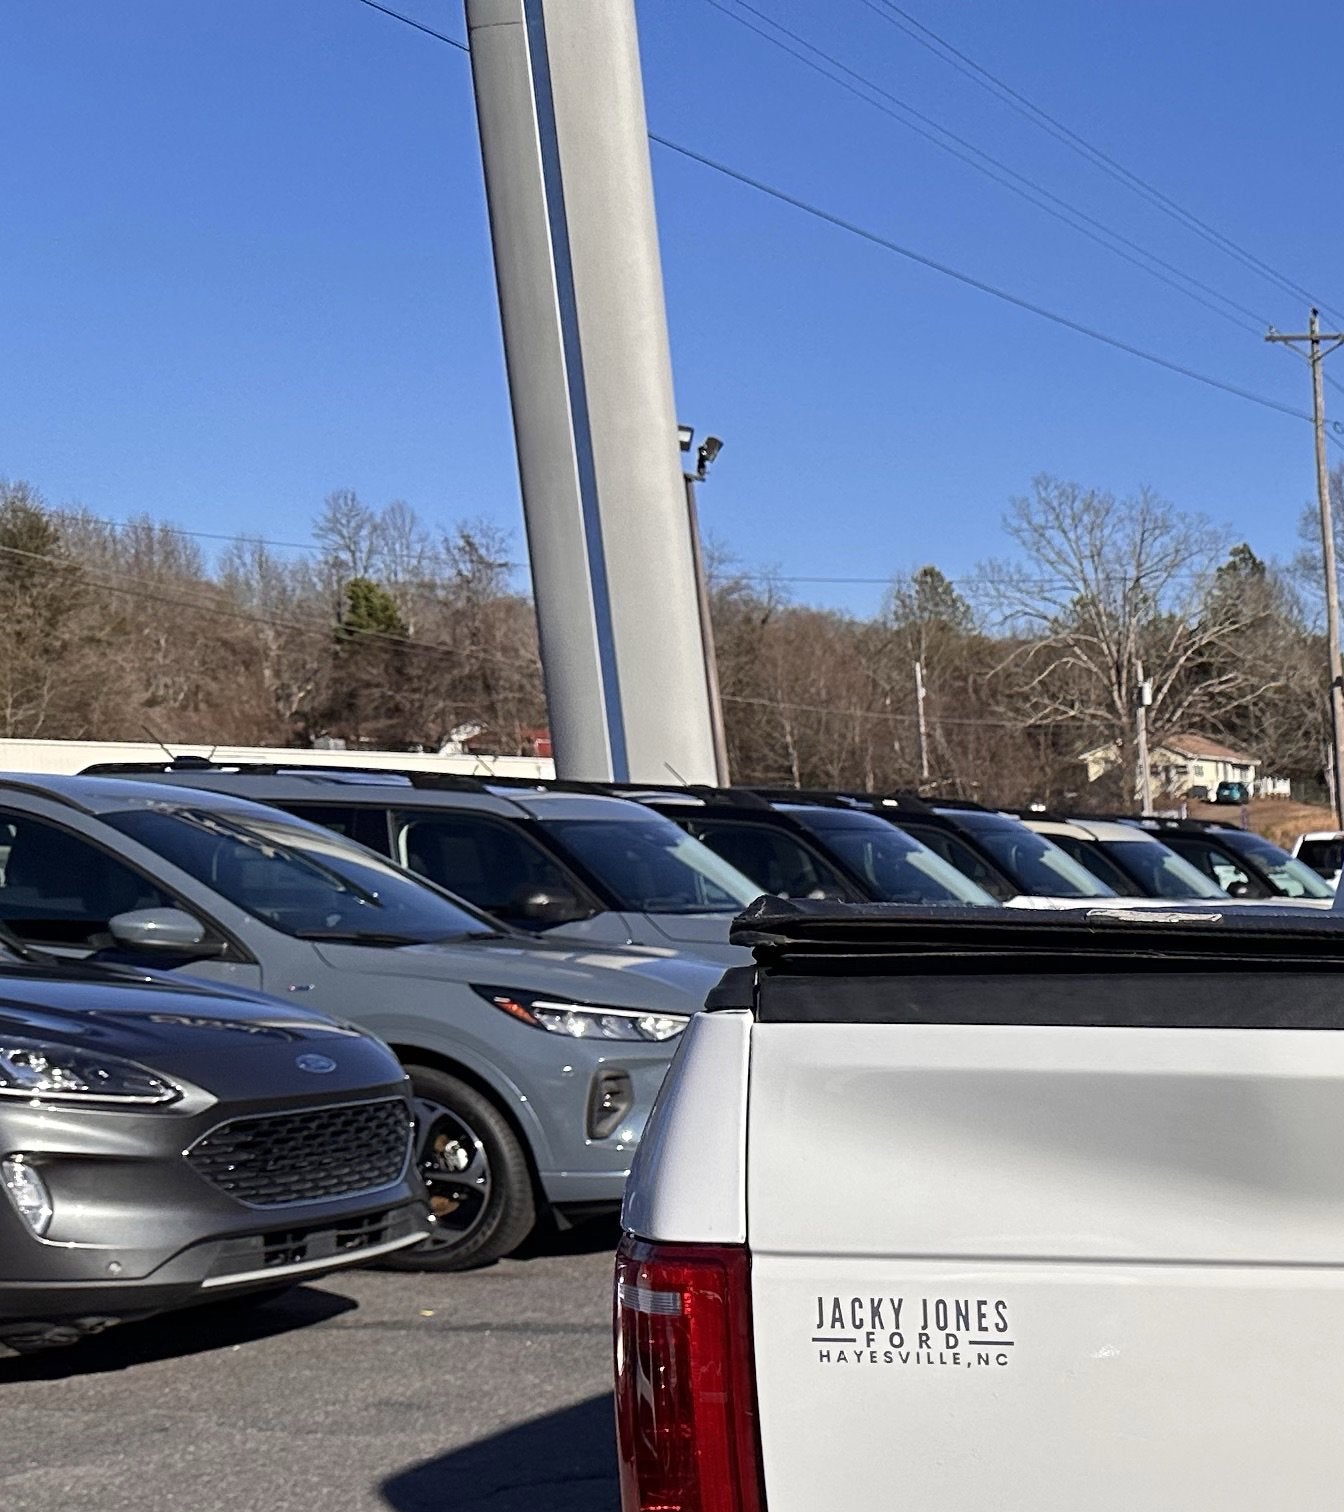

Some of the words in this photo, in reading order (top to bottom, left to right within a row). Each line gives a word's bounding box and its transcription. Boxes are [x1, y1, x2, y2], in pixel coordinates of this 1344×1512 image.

[816, 1296, 904, 1330] JACKY
[921, 1298, 1009, 1333] JONES
[865, 1331, 960, 1350] FORD
